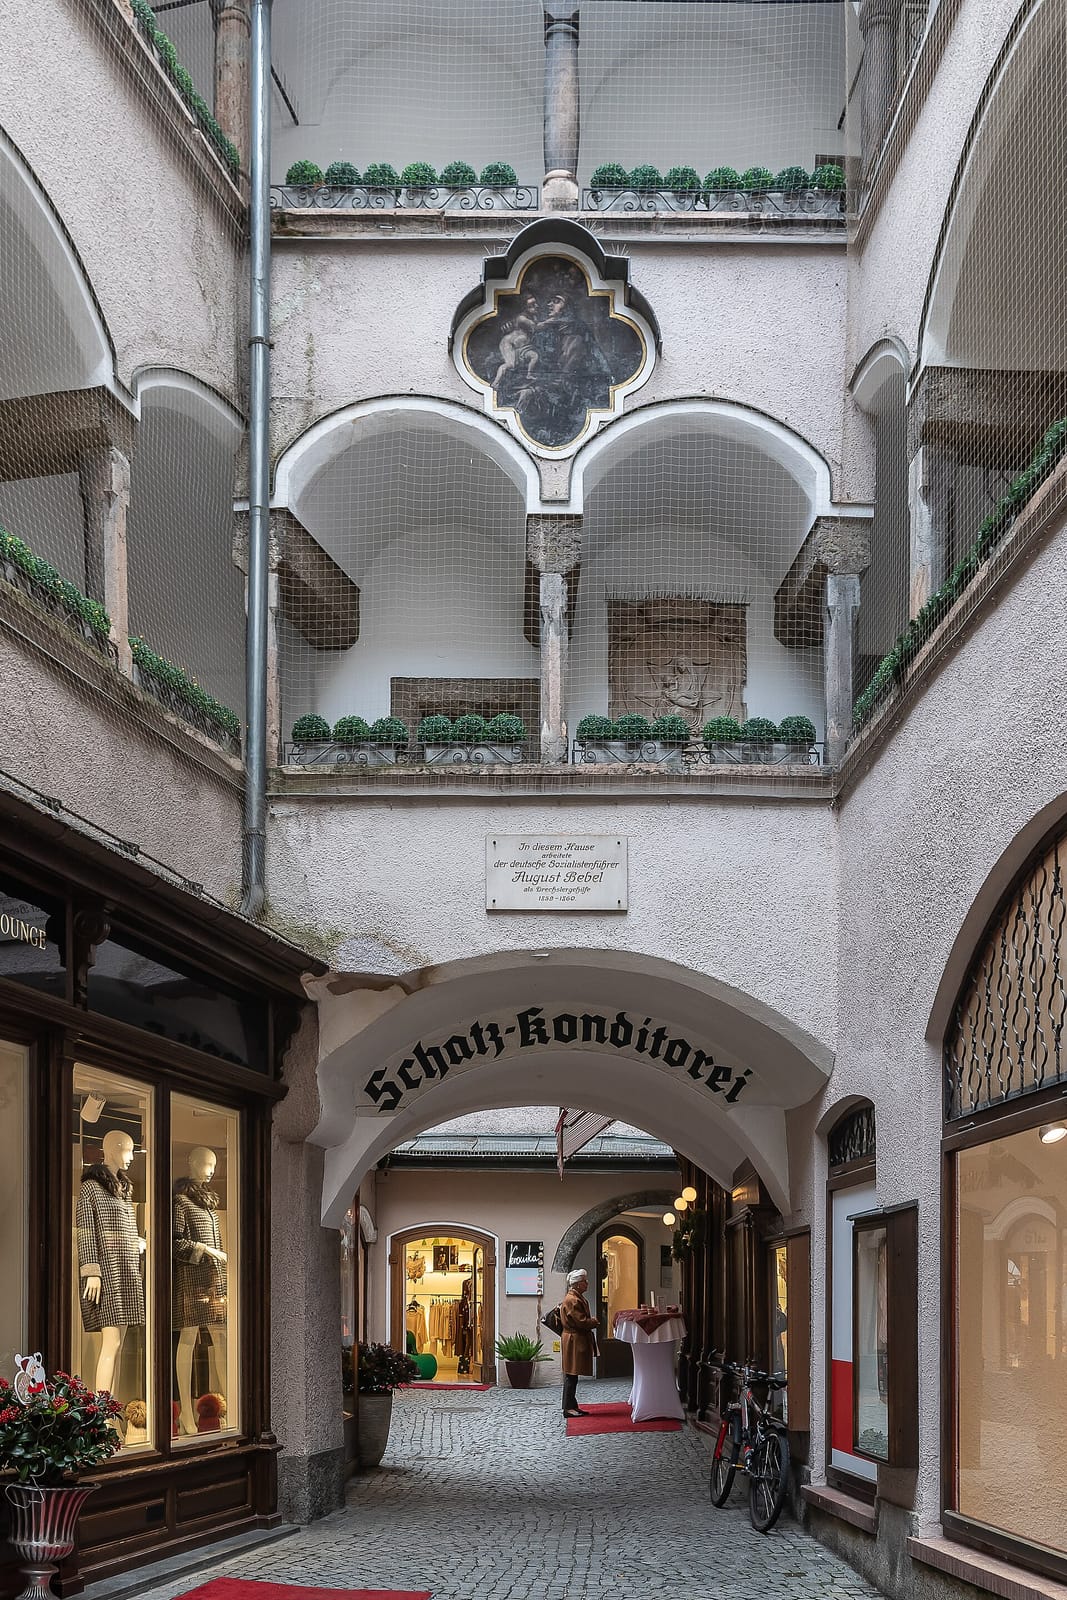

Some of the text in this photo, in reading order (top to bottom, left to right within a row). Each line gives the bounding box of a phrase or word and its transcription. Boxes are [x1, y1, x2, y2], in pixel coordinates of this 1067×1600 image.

[518, 842, 595, 851] In diesem Hause
[493, 860, 620, 870] der deutsche Sozialistenführer
[511, 871, 604, 886] August Bebel
[535, 886, 591, 895] Drechslergehilfe
[363, 1007, 754, 1113] Schatz-Konditorei
